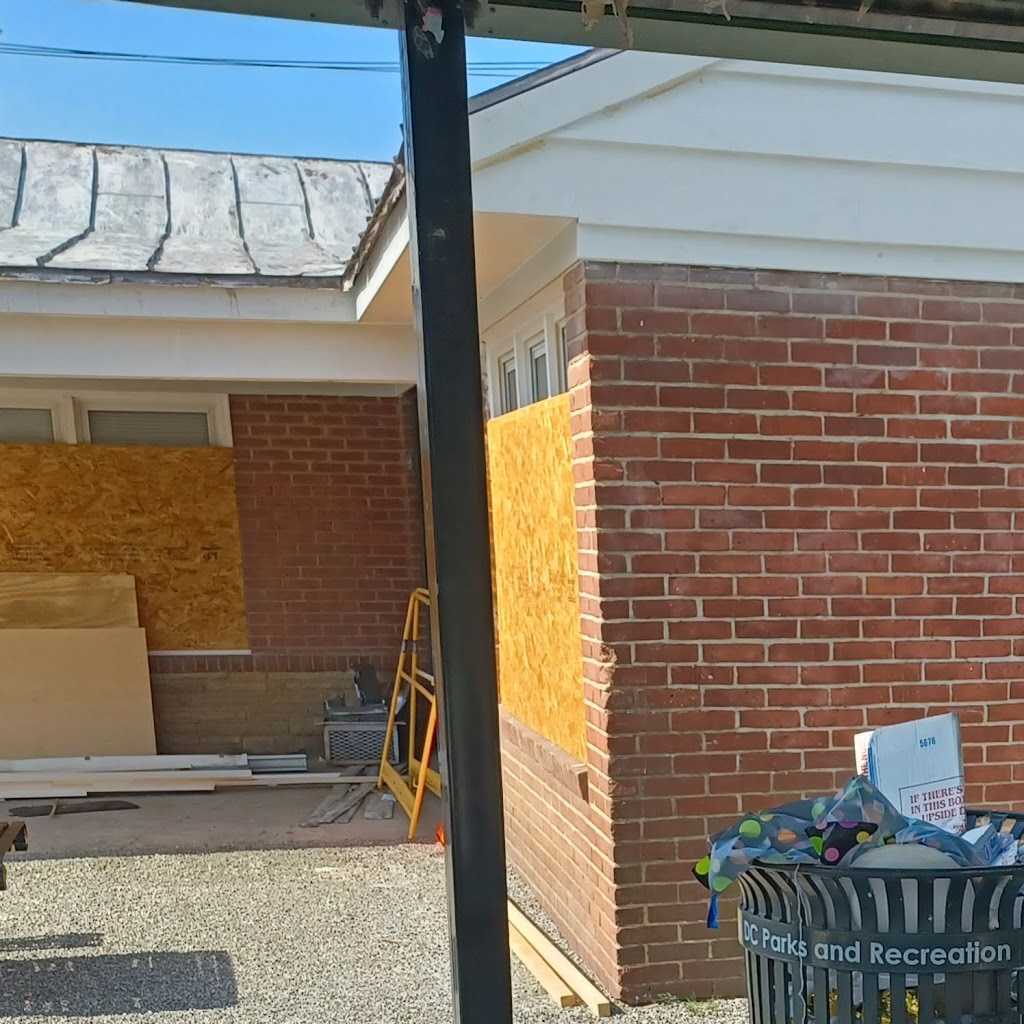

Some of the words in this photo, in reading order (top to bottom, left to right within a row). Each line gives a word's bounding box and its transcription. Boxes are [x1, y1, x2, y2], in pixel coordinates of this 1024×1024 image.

[919, 737, 936, 748] 5678
[910, 793, 920, 804] IF
[921, 785, 963, 801] THERE'S
[911, 804, 921, 815] IN
[923, 799, 946, 812] THIS
[921, 808, 957, 821] UPSIDE
[744, 920, 759, 946] DC
[762, 928, 808, 958] Parks
[814, 940, 861, 964] and
[869, 940, 1012, 966] Recreation
